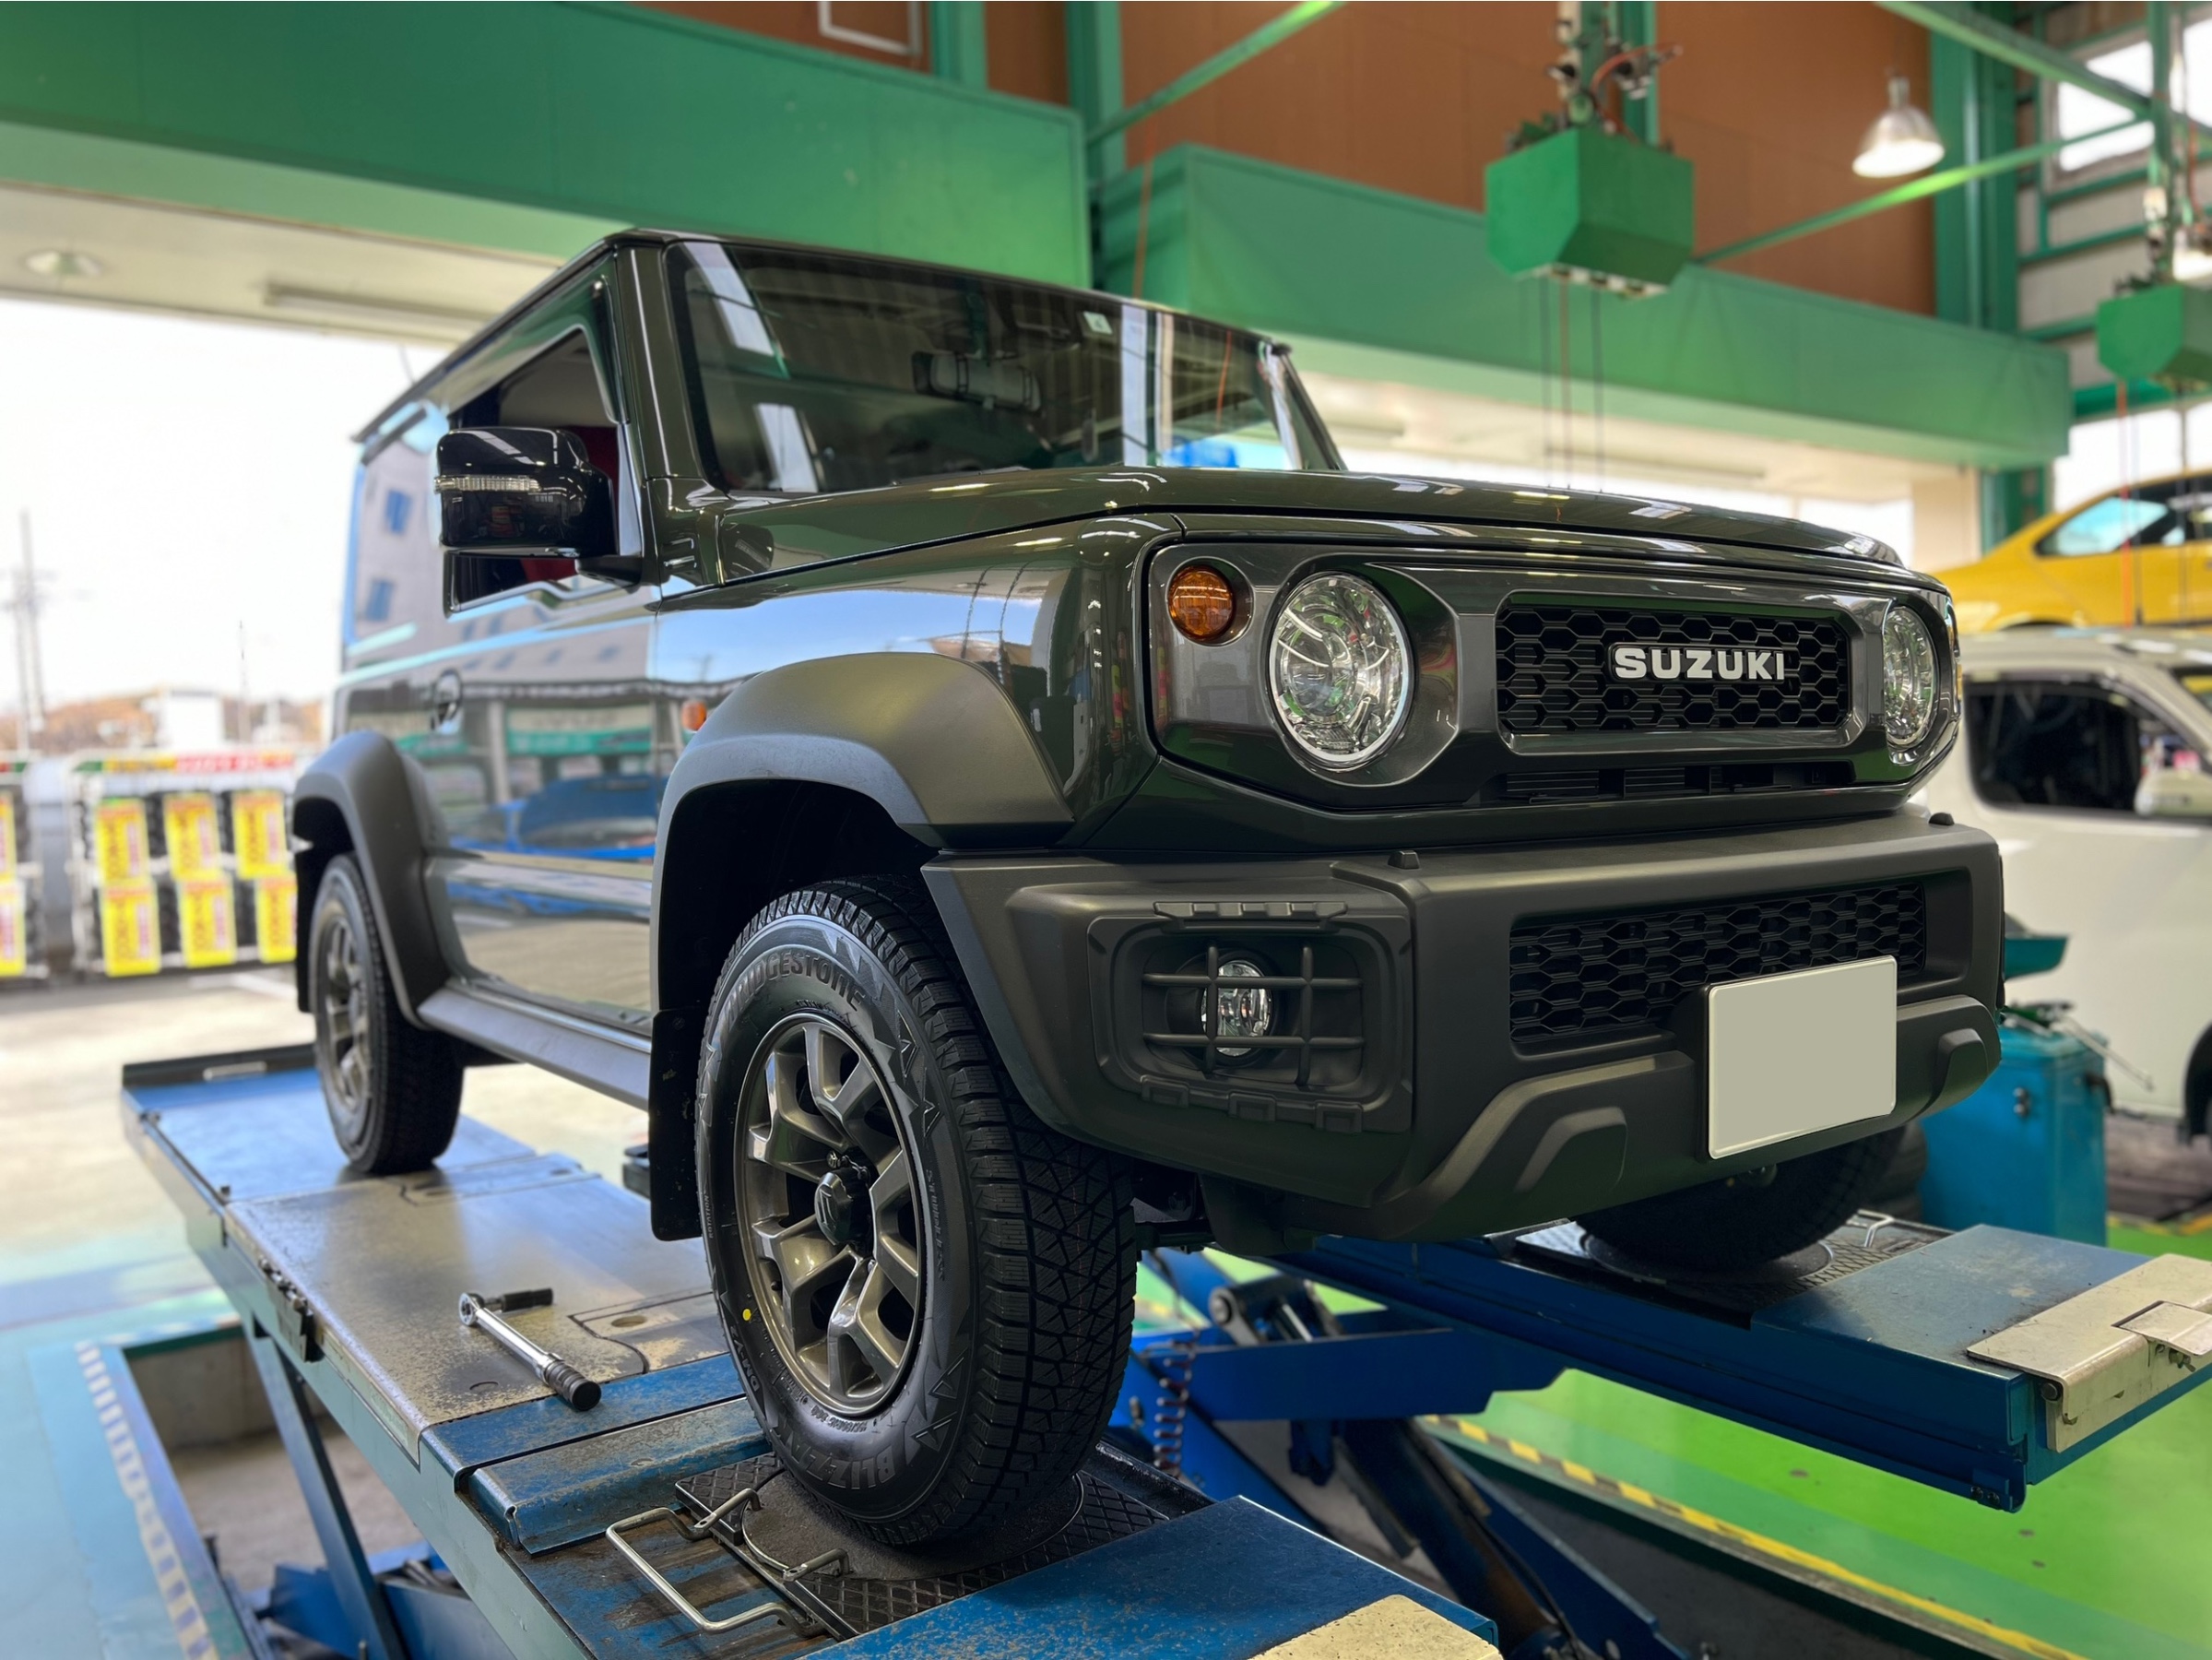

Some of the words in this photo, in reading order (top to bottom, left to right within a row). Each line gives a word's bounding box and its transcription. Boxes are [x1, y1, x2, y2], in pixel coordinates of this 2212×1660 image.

[1615, 647, 1785, 681] SUZUKI
[723, 950, 866, 1028] BRIDGESTONE
[704, 1194, 714, 1239] ROTATION
[773, 1416, 896, 1489] BLIZZAK
